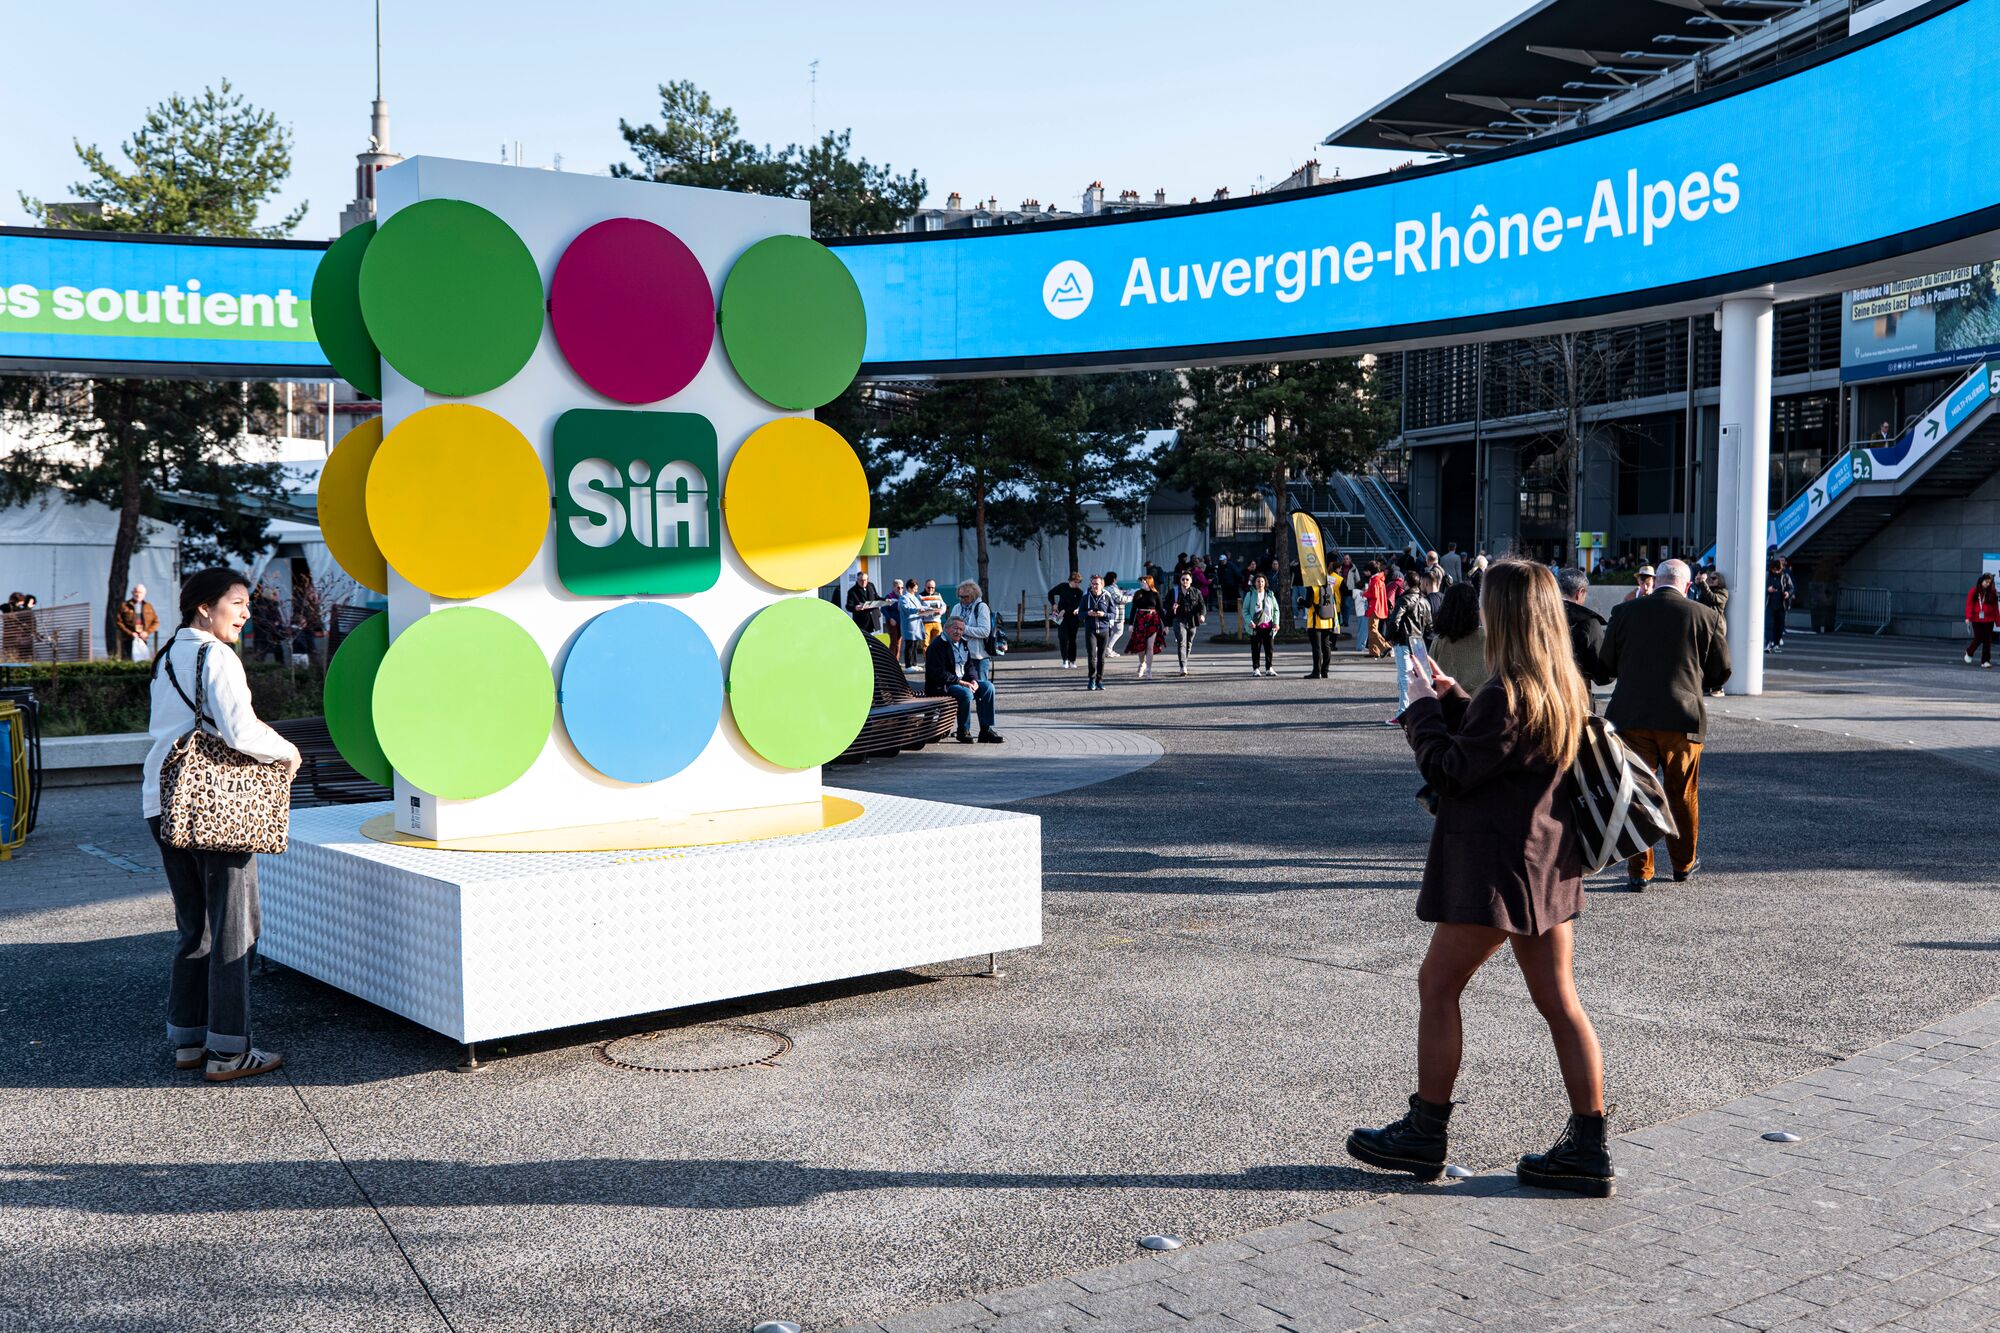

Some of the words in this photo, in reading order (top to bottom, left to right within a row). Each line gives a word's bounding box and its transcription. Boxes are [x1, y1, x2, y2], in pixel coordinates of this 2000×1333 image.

[1120, 162, 1740, 307] Auvergne-Rhône-Alpes
[1973, 264, 1980, 276] et
[0, 283, 41, 319] s
[52, 278, 298, 328] soutient
[1854, 305, 1870, 318] Seine
[1872, 300, 1891, 314] Grands
[1893, 298, 1907, 311] Lacs
[1910, 294, 1925, 307] dans
[1926, 292, 1933, 304] le
[1933, 286, 1959, 303] Pavillon
[1960, 282, 1970, 297] 5.2
[1853, 457, 1870, 479] 5.2
[205, 771, 252, 793] BALZAC
[235, 791, 253, 799] PARIS
